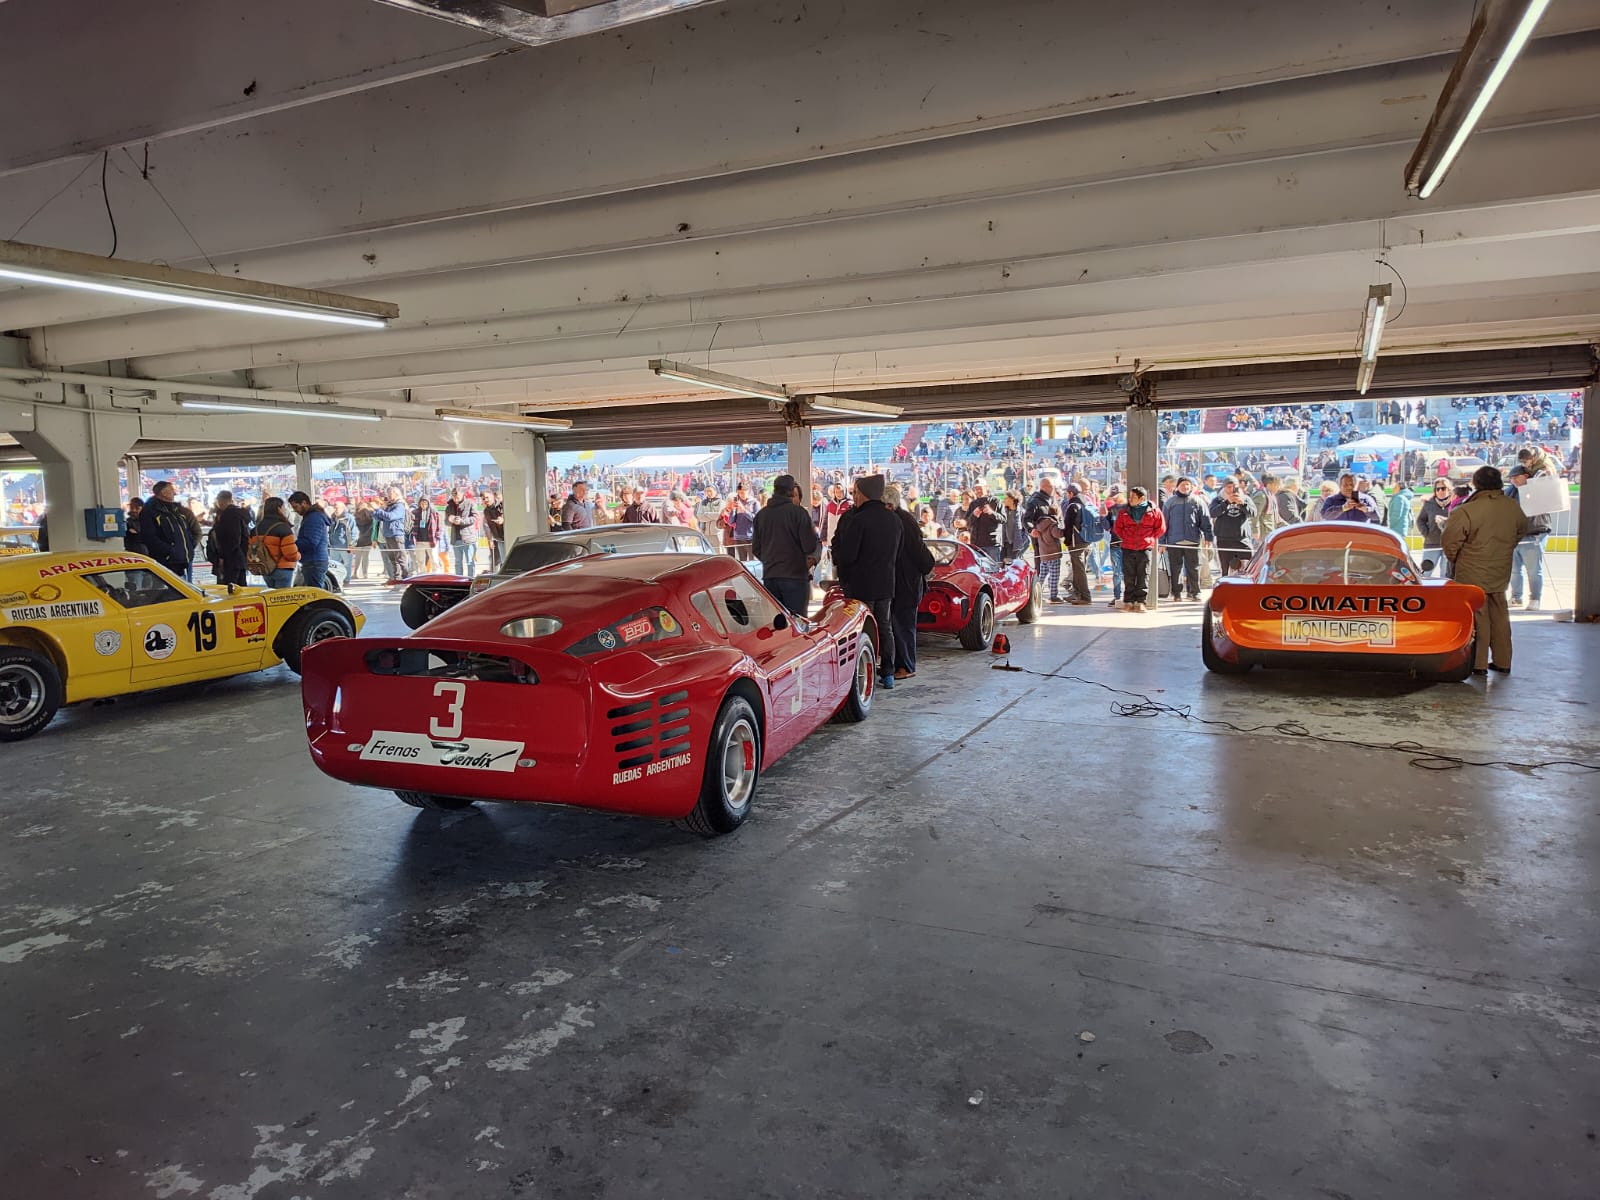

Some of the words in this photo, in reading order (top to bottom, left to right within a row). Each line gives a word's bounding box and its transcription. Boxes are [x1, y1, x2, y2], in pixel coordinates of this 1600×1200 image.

[11, 606, 47, 621] RUEDAS
[50, 601, 100, 618] ARGENTINAS
[1259, 595, 1426, 613] GOMATRO
[187, 609, 217, 652] 19
[240, 616, 259, 625] SHELL
[1289, 619, 1390, 640] MONTENEGRO
[430, 681, 466, 739] 3
[369, 740, 421, 758] Frenos
[612, 766, 643, 785] RUEDAS
[646, 752, 691, 777] ARGENTINAS
